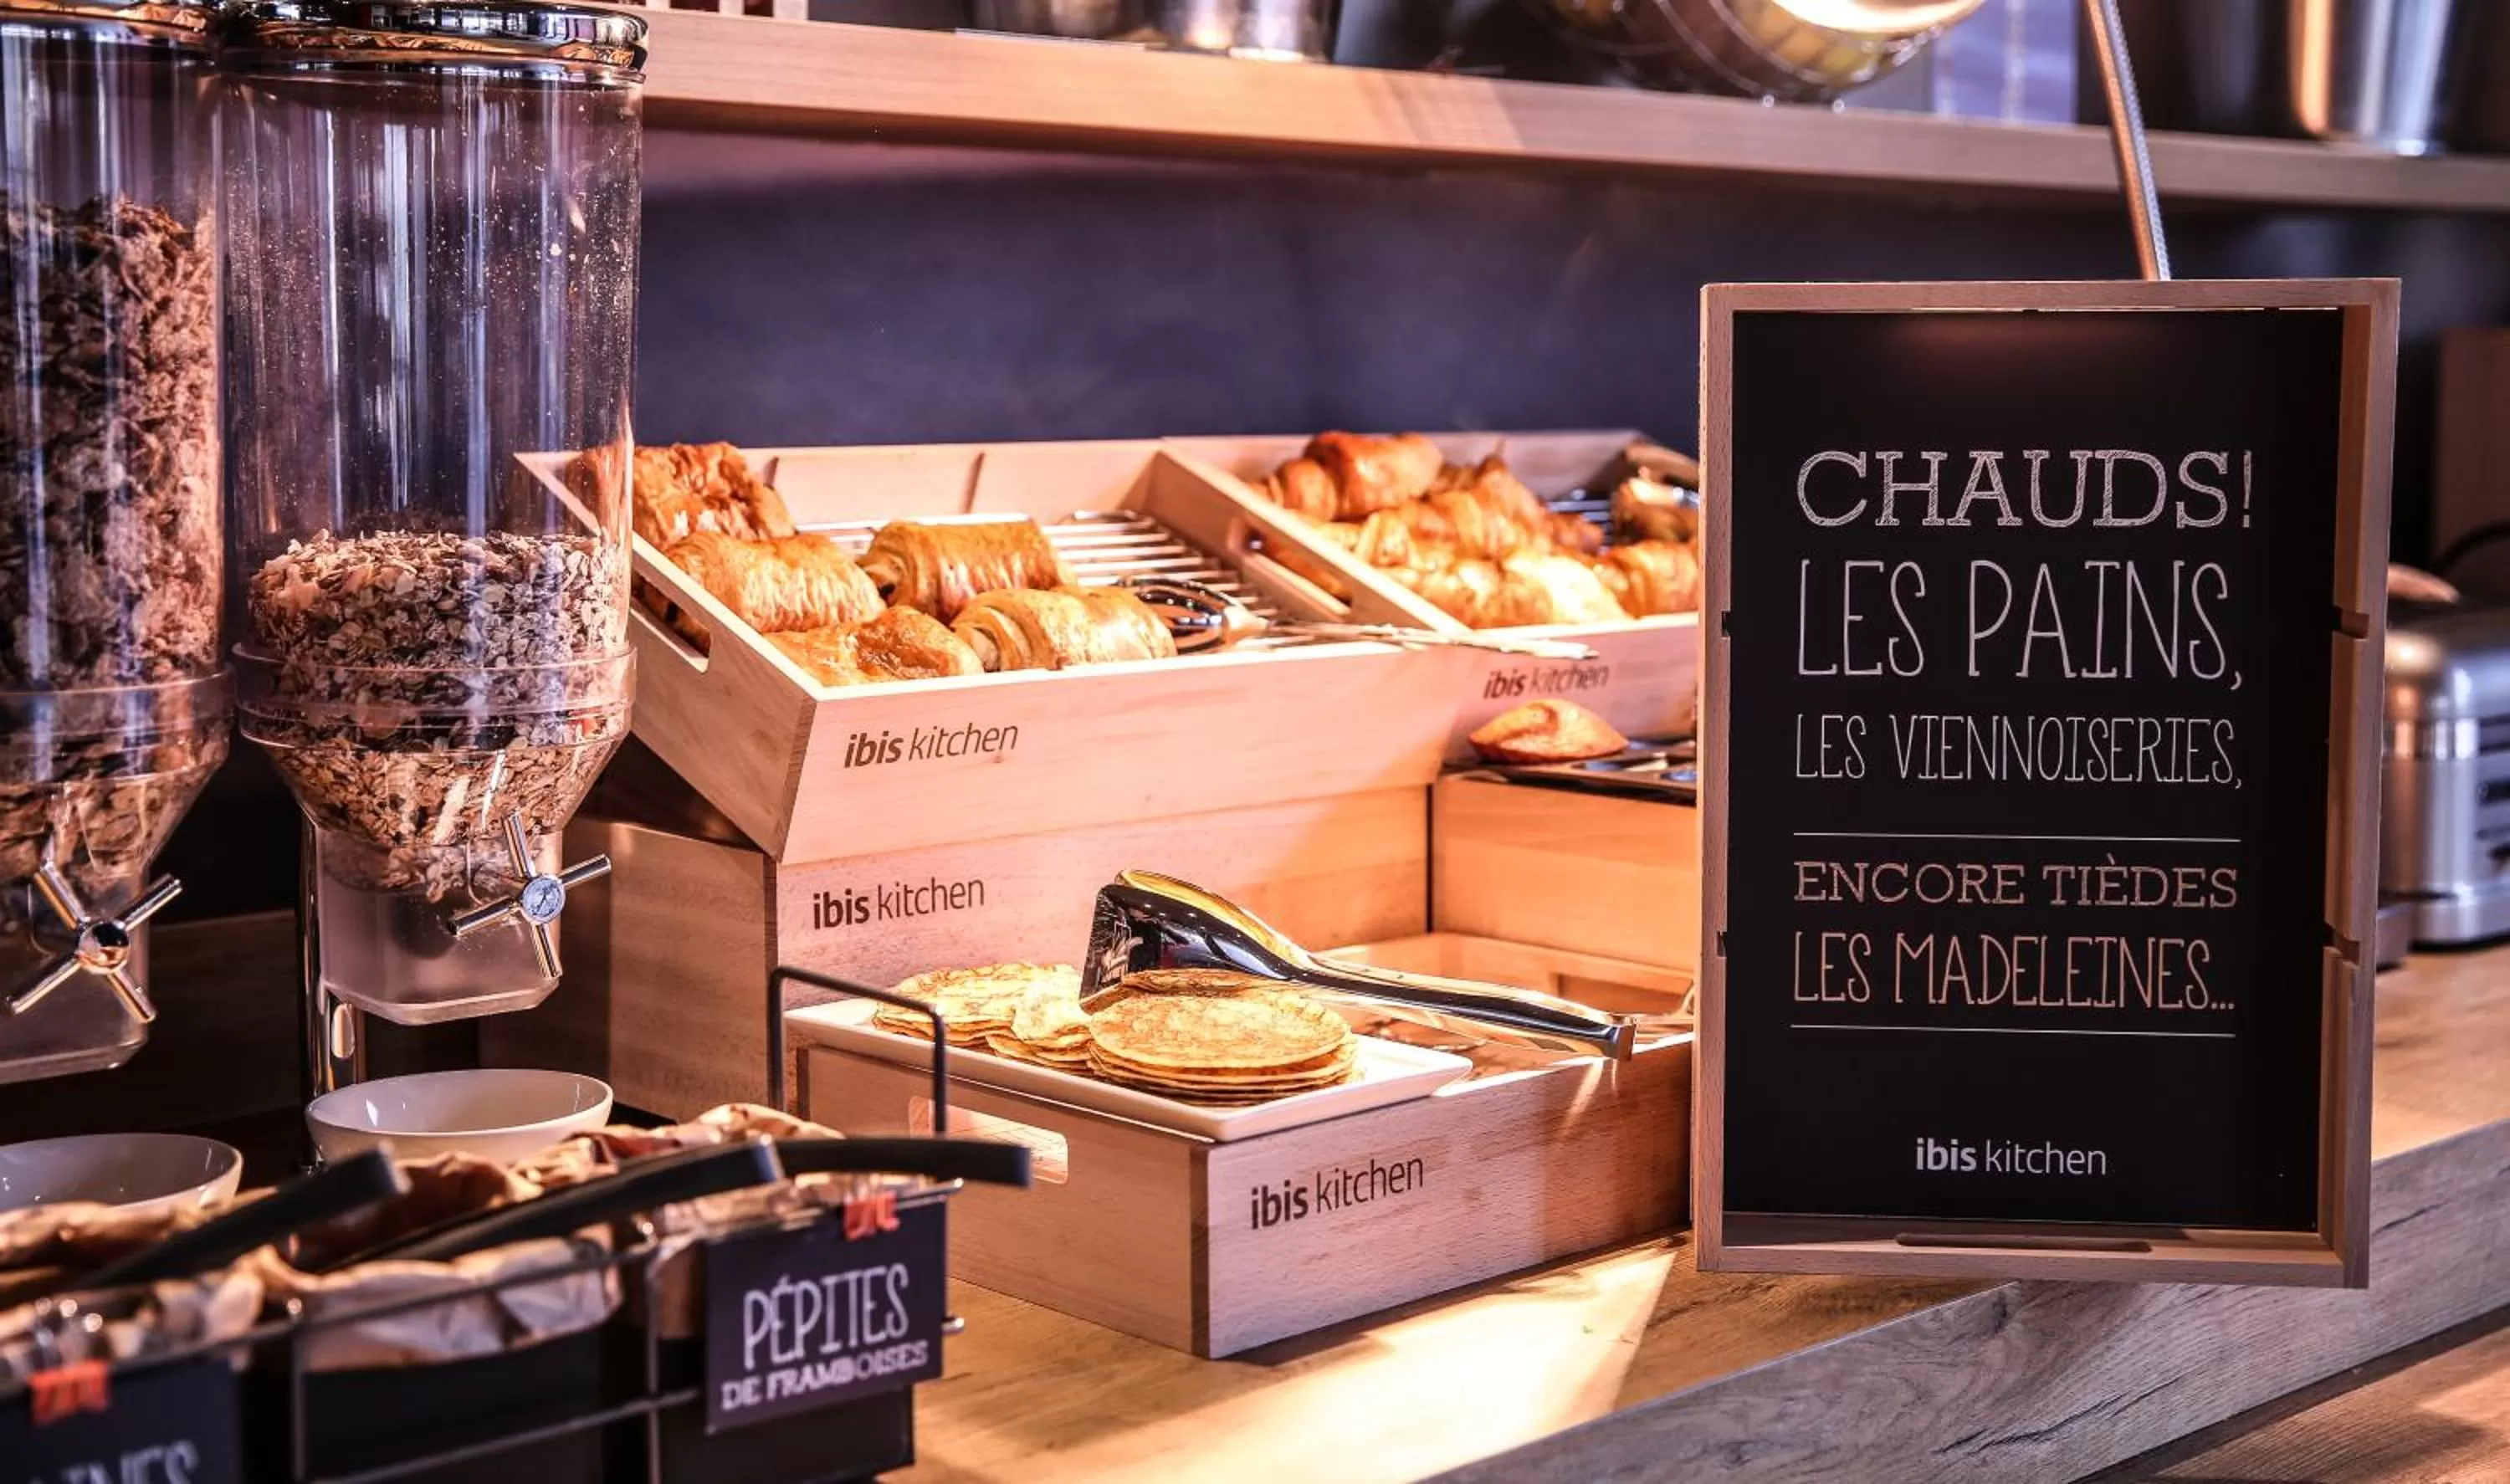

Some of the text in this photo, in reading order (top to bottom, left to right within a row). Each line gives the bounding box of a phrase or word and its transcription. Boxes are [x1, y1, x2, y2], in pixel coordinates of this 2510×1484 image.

[1797, 450, 2252, 529] CHAUDS!
[1799, 560, 2242, 691] LES PAINS,
[1483, 663, 1610, 699] ibis kitchen
[843, 722, 1018, 768] ibis kitchen
[1796, 714, 2242, 790] LES VIENNOISERIES,
[812, 876, 985, 930] ibis kitchen
[1794, 853, 2237, 908] ENCORE TIÈDES
[1795, 932, 2235, 1011] LES MADELEINES...
[1916, 1138, 2107, 1176] ibis kitchen
[1251, 1158, 1424, 1230] ibis kitchen
[743, 1263, 909, 1369] PÉPITES
[721, 1340, 929, 1410] DE FRAMBOISES
